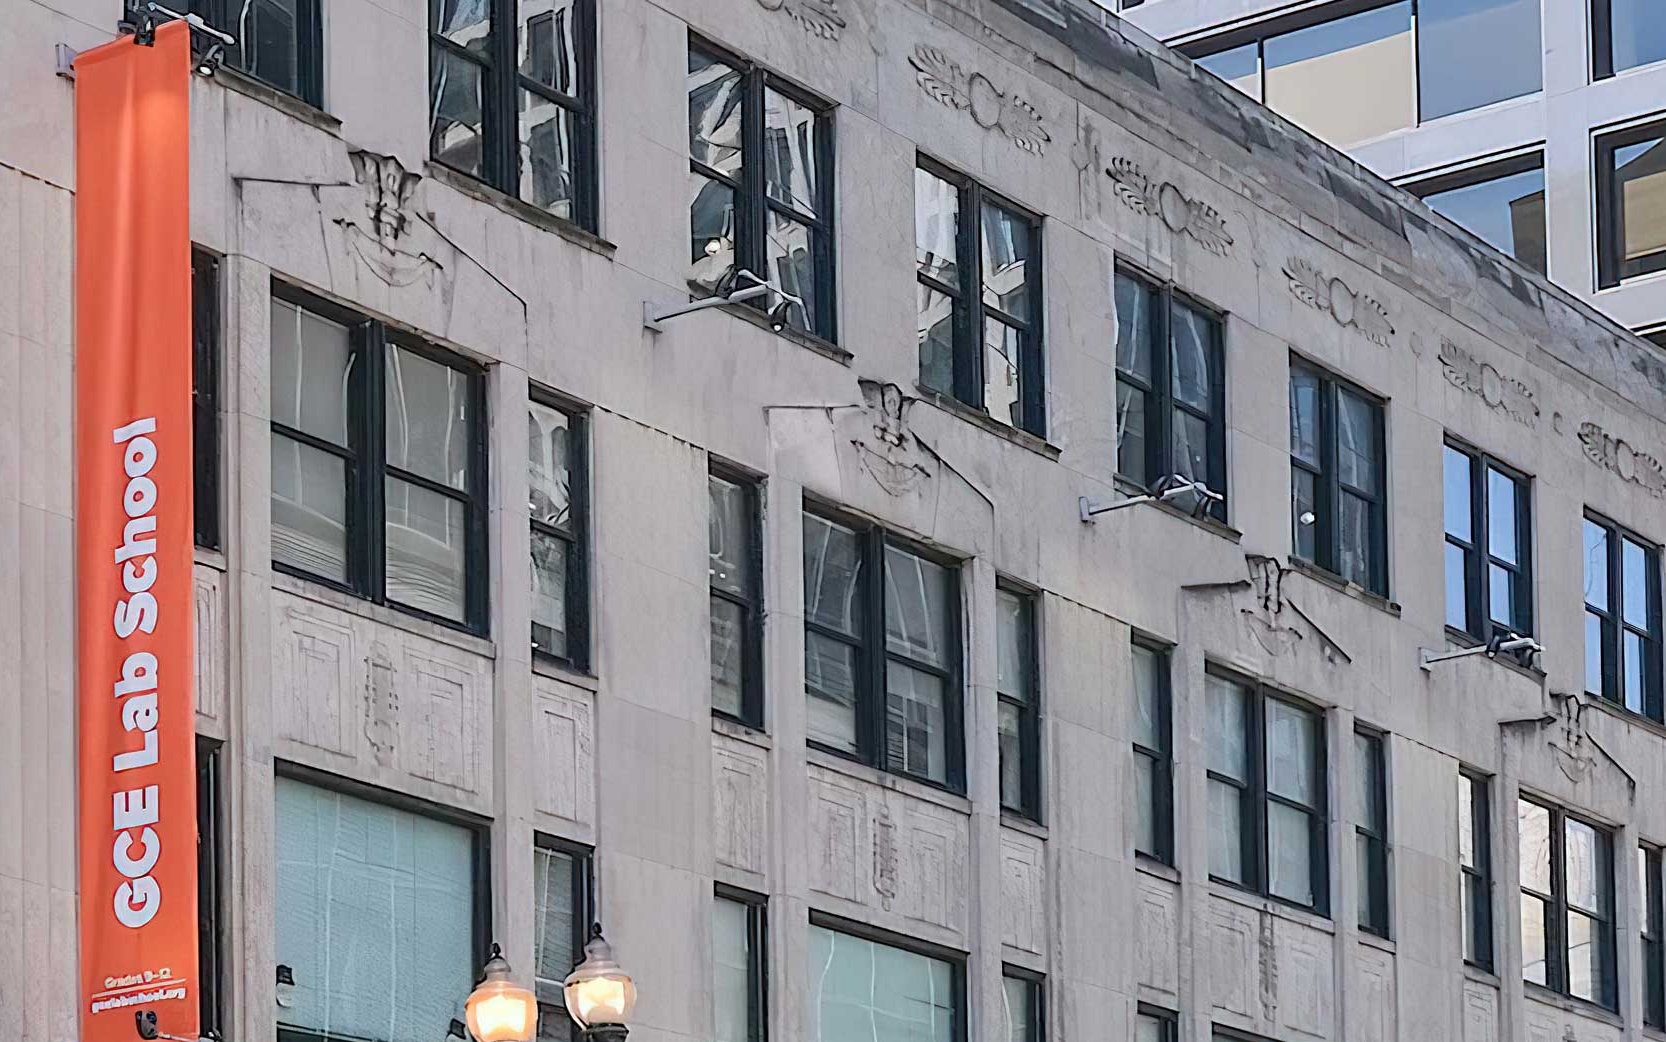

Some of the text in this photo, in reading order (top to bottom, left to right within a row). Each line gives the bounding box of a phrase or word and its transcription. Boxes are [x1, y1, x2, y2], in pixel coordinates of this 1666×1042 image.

[113, 416, 161, 929] GCE Lab School
